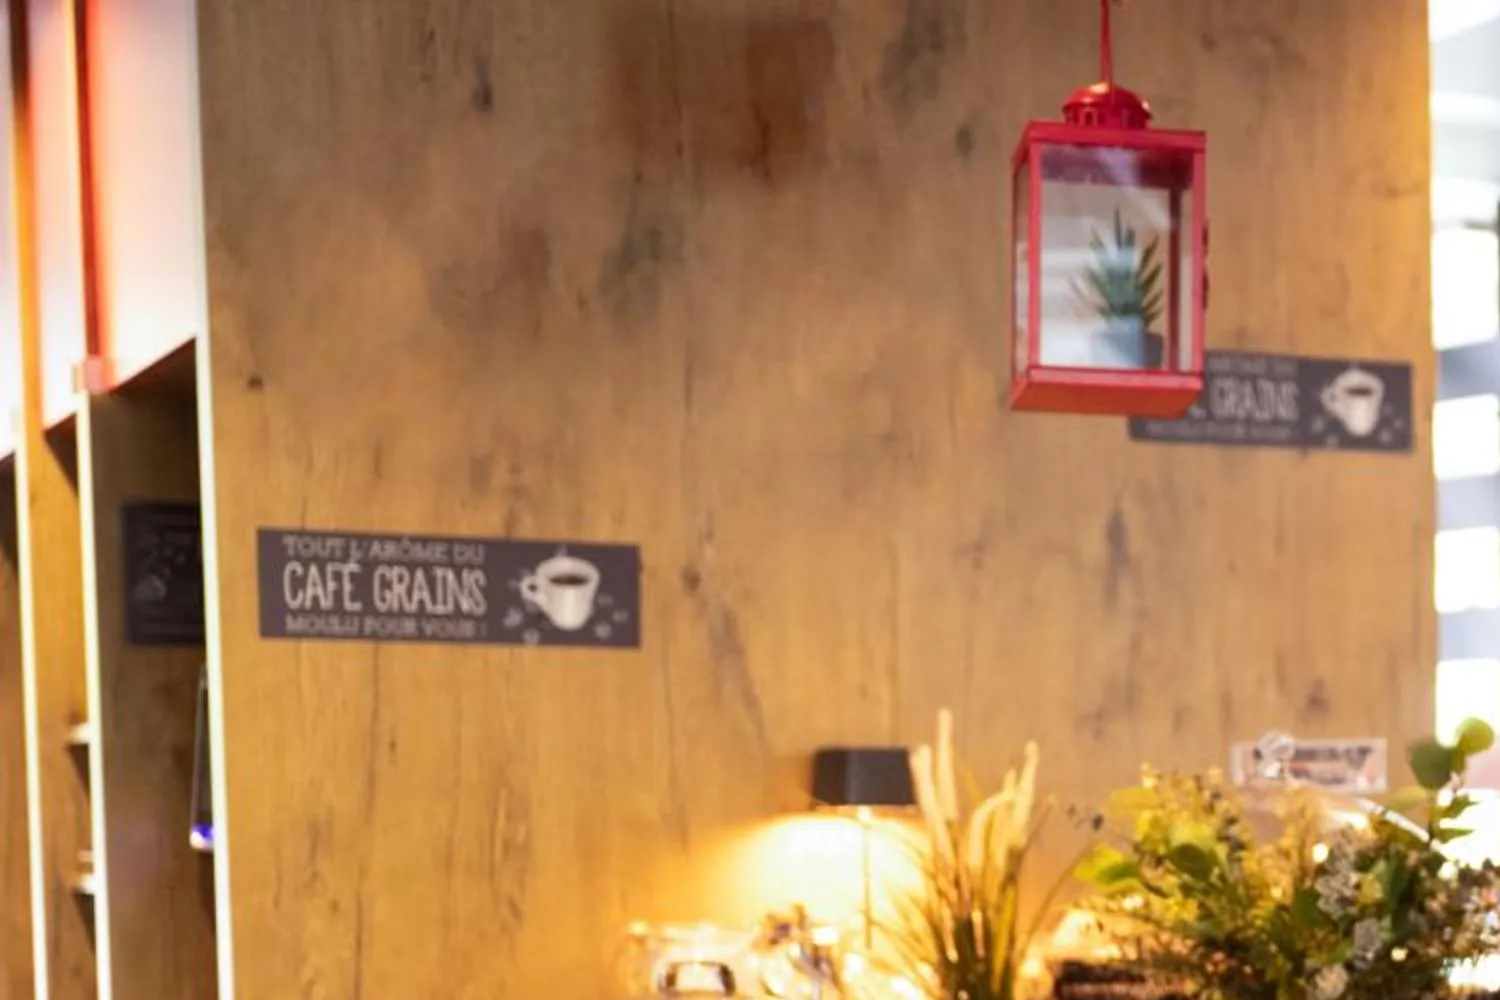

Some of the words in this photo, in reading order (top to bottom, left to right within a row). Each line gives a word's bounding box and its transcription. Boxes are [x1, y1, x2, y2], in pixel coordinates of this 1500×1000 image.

[282, 534, 346, 559] TOUT
[452, 542, 486, 565] DU
[282, 558, 363, 612] CAFÉ
[372, 563, 487, 617] GRAINS
[363, 615, 417, 636] POUR
